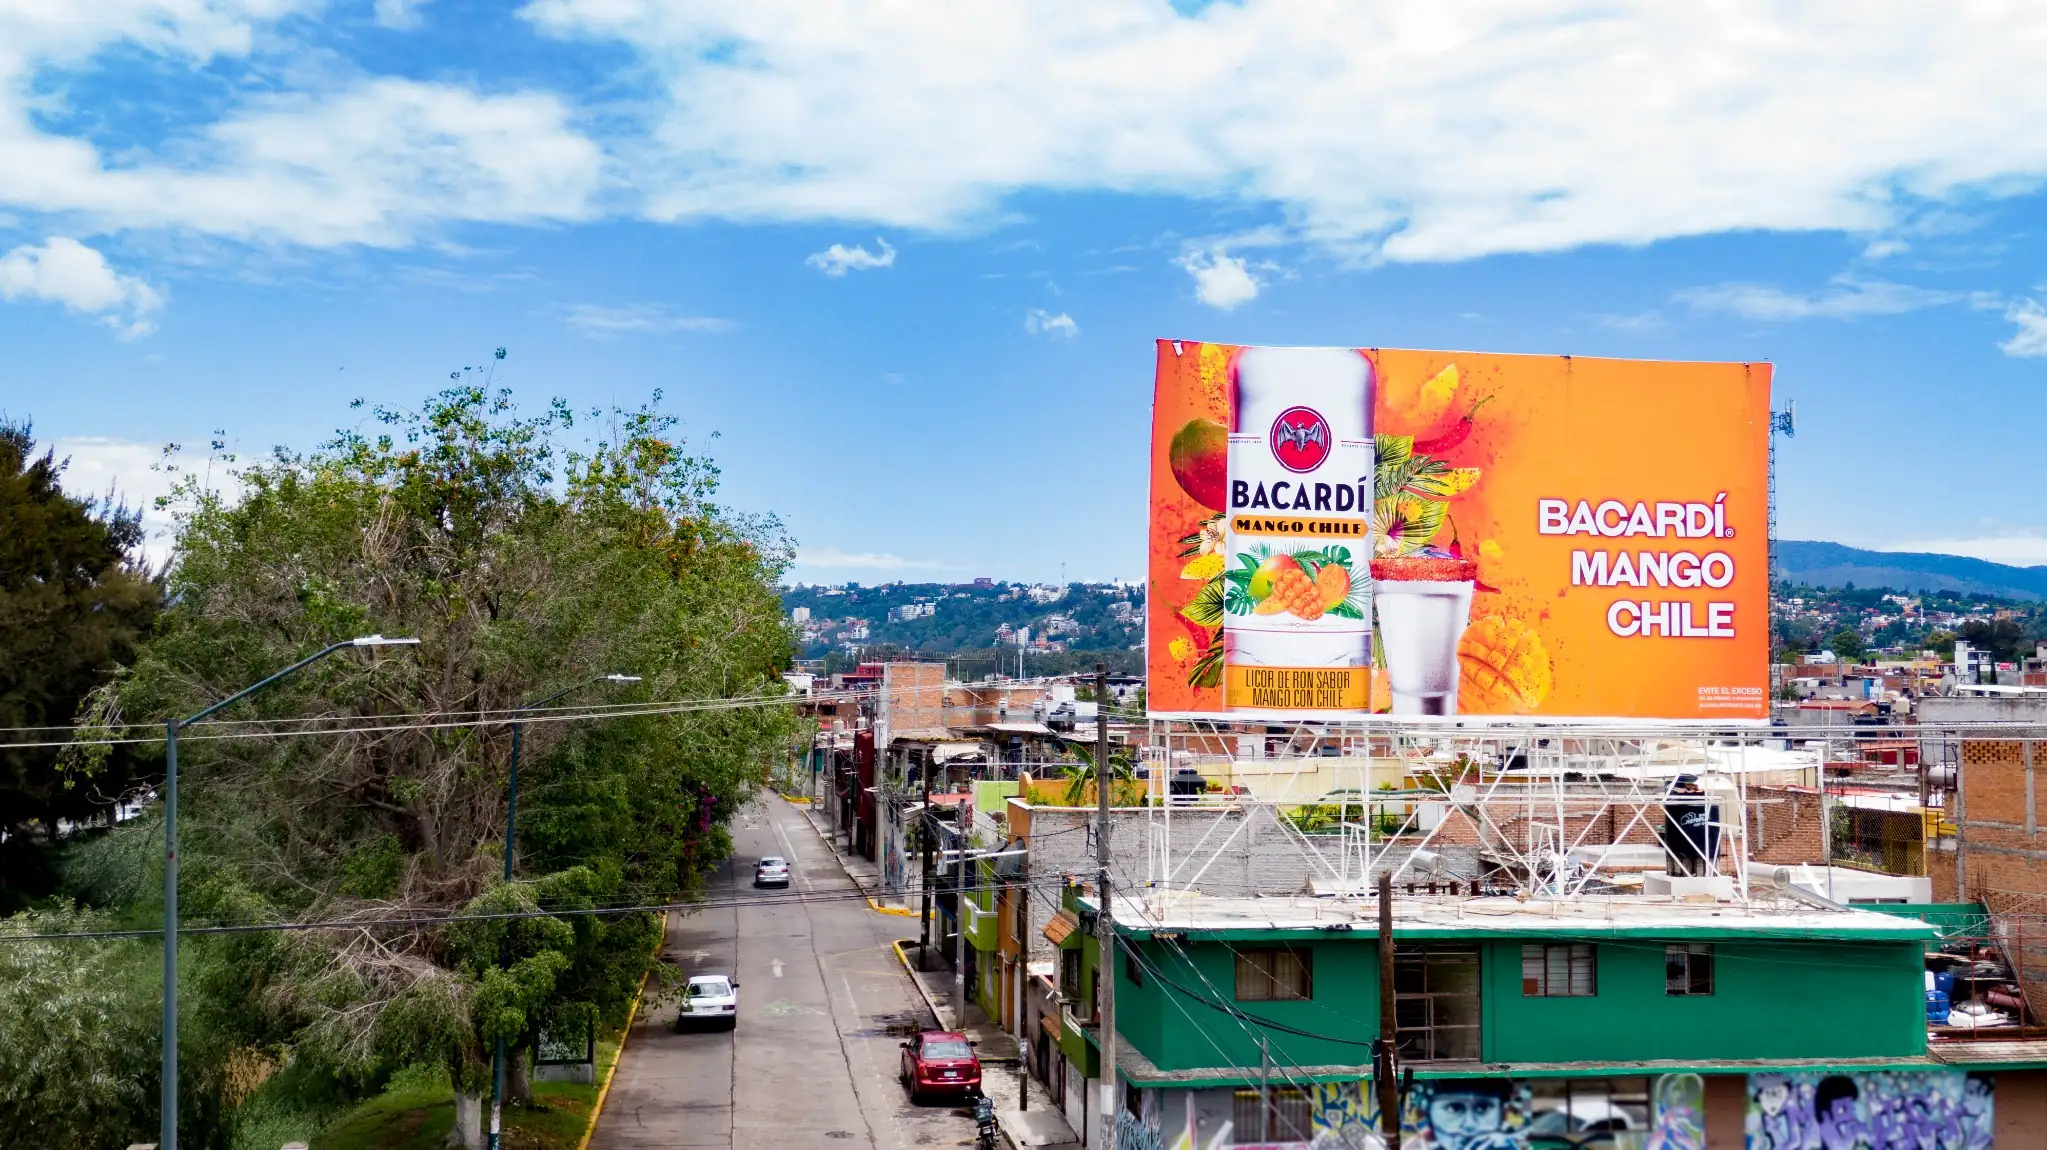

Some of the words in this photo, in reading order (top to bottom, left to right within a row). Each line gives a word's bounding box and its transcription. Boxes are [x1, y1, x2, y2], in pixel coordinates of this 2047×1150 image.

[1231, 475, 1367, 513] BACARDÍ
[1236, 519, 1304, 533] MANGO
[1308, 521, 1362, 535] CHILE
[1571, 550, 1735, 588] MANGO
[1607, 600, 1735, 637] CHILE
[1245, 669, 1274, 688] LICOR
[1277, 670, 1290, 689] DE
[1292, 670, 1314, 689] RON
[1316, 671, 1350, 689] SABOR
[1252, 688, 1291, 707] MANGO
[1293, 689, 1314, 708] CON
[1316, 689, 1344, 708] CHILE
[1698, 687, 1720, 695] EVITE
[1721, 687, 1730, 695] EL
[1731, 687, 1762, 695] EXCESO
